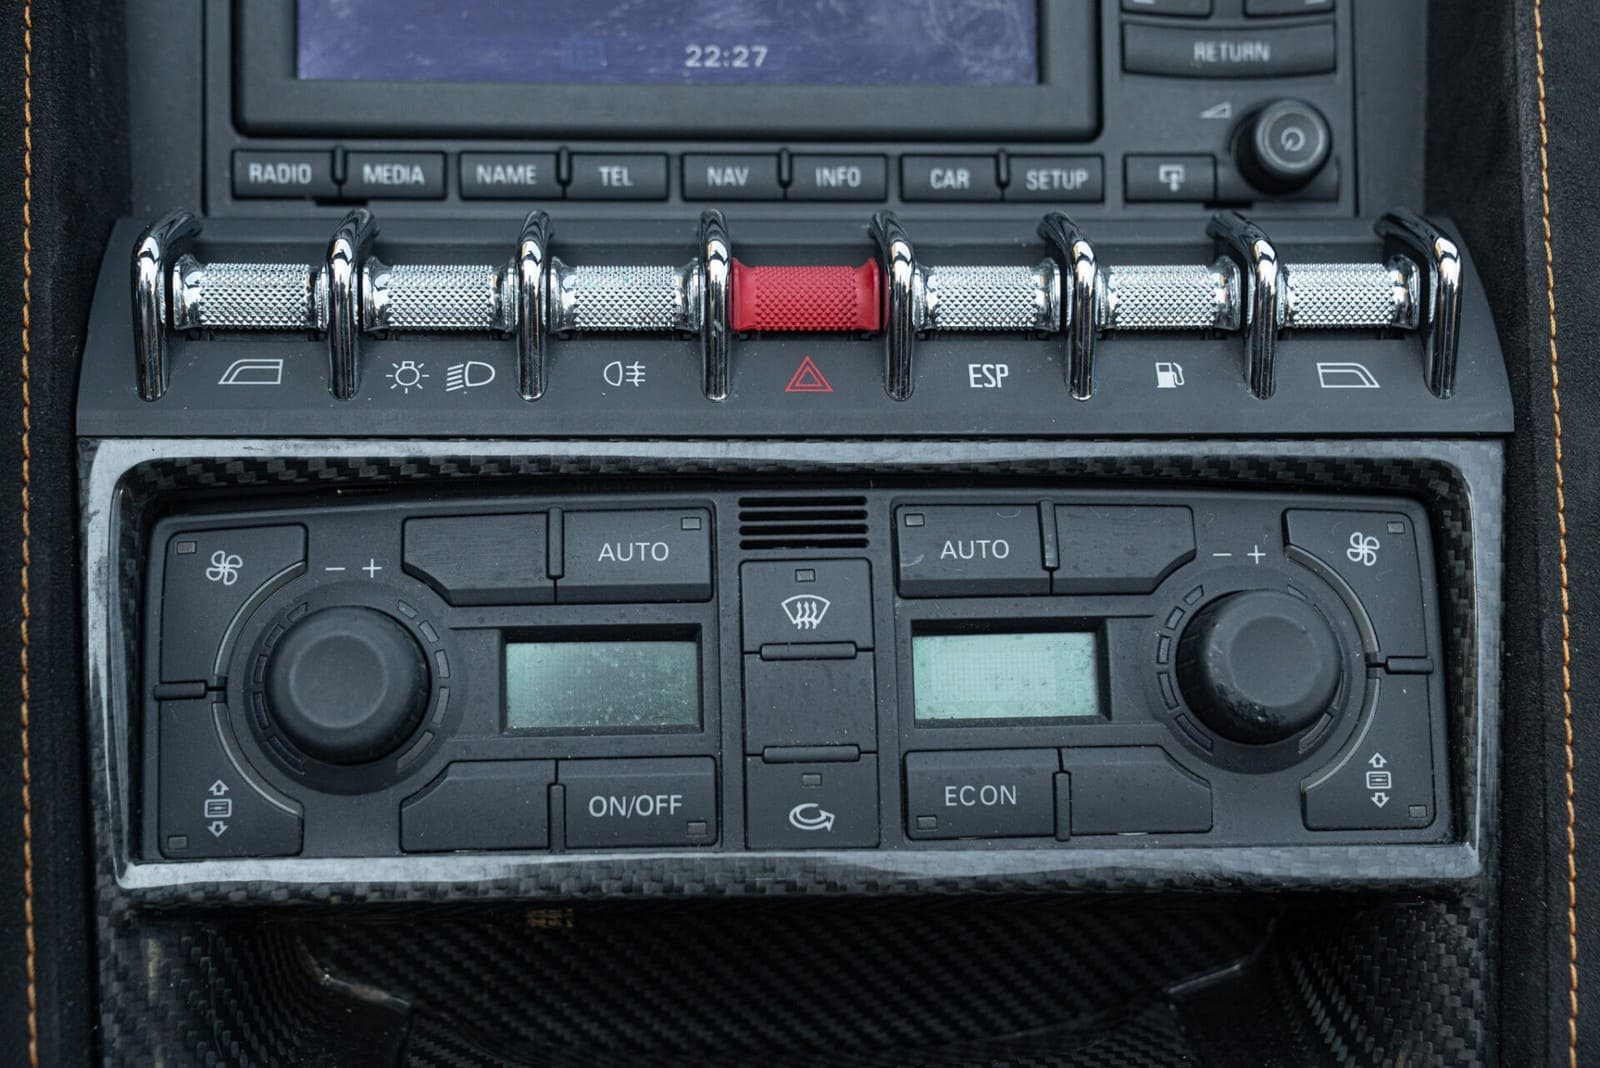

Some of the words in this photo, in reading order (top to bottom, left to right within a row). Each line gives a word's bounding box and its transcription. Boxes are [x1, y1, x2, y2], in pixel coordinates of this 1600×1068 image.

[685, 44, 769, 69] 22:27
[1193, 41, 1271, 62] RETURN
[248, 163, 312, 184] RADIO
[362, 164, 426, 185] MEDIA
[476, 164, 537, 185] NAME
[598, 165, 633, 188] TEL
[706, 166, 750, 187] NAV
[815, 166, 861, 188] INFO
[930, 168, 970, 190] CAR
[1025, 169, 1089, 190] SETUP
[967, 363, 1009, 390] ESP
[597, 541, 669, 562] AUTO
[939, 538, 1010, 560] AUTO
[588, 794, 683, 819] ON/OFF
[943, 784, 1018, 807] ECON
